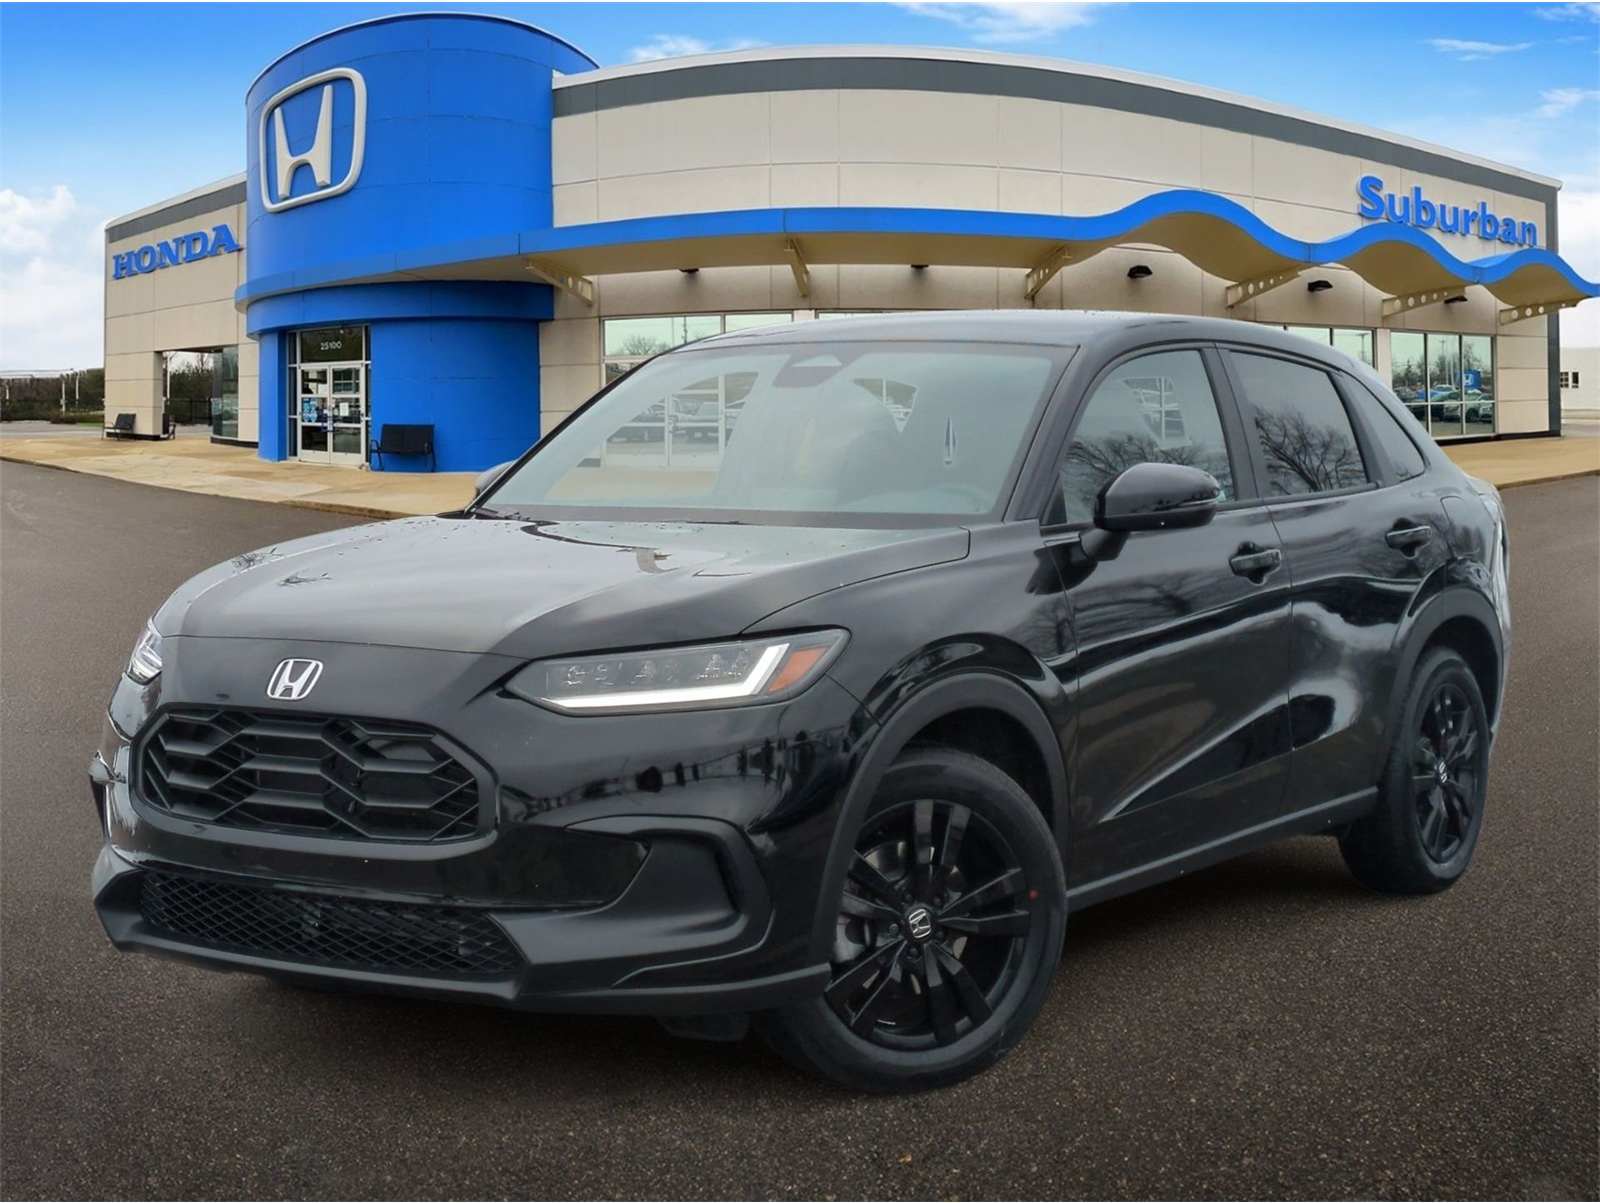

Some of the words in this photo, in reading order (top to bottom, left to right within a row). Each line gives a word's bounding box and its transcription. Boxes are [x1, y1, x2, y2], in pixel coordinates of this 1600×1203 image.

[1358, 175, 1538, 248] Suburban
[112, 223, 242, 280] HONDA
[320, 340, 342, 350] 25100
